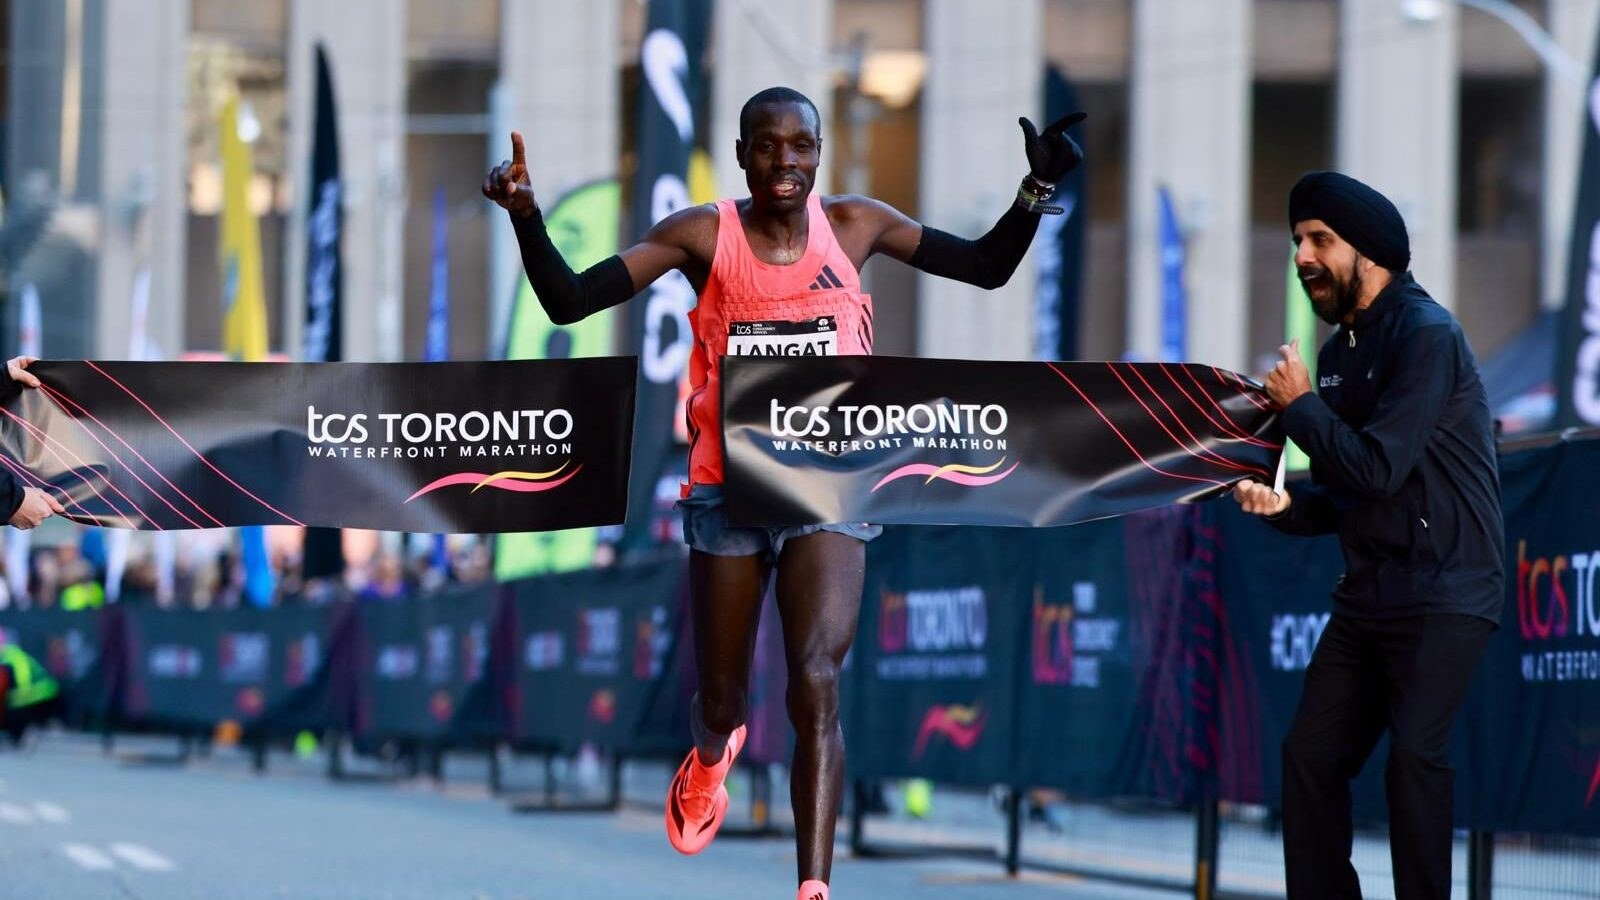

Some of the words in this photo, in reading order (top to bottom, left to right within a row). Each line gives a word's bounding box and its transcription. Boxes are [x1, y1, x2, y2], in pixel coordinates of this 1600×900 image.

[736, 324, 751, 335] tcs
[736, 341, 830, 356] LANGAT
[307, 405, 369, 443] tcs
[378, 408, 573, 443] TORONTO
[770, 398, 830, 437] tcs
[837, 404, 1008, 436] TORONTO
[308, 446, 447, 458] WATERFRONT
[459, 443, 571, 457] MARATHON
[772, 438, 902, 452] WATERFRONT
[912, 437, 1007, 450] MARATHON
[1517, 539, 1568, 640] tcs
